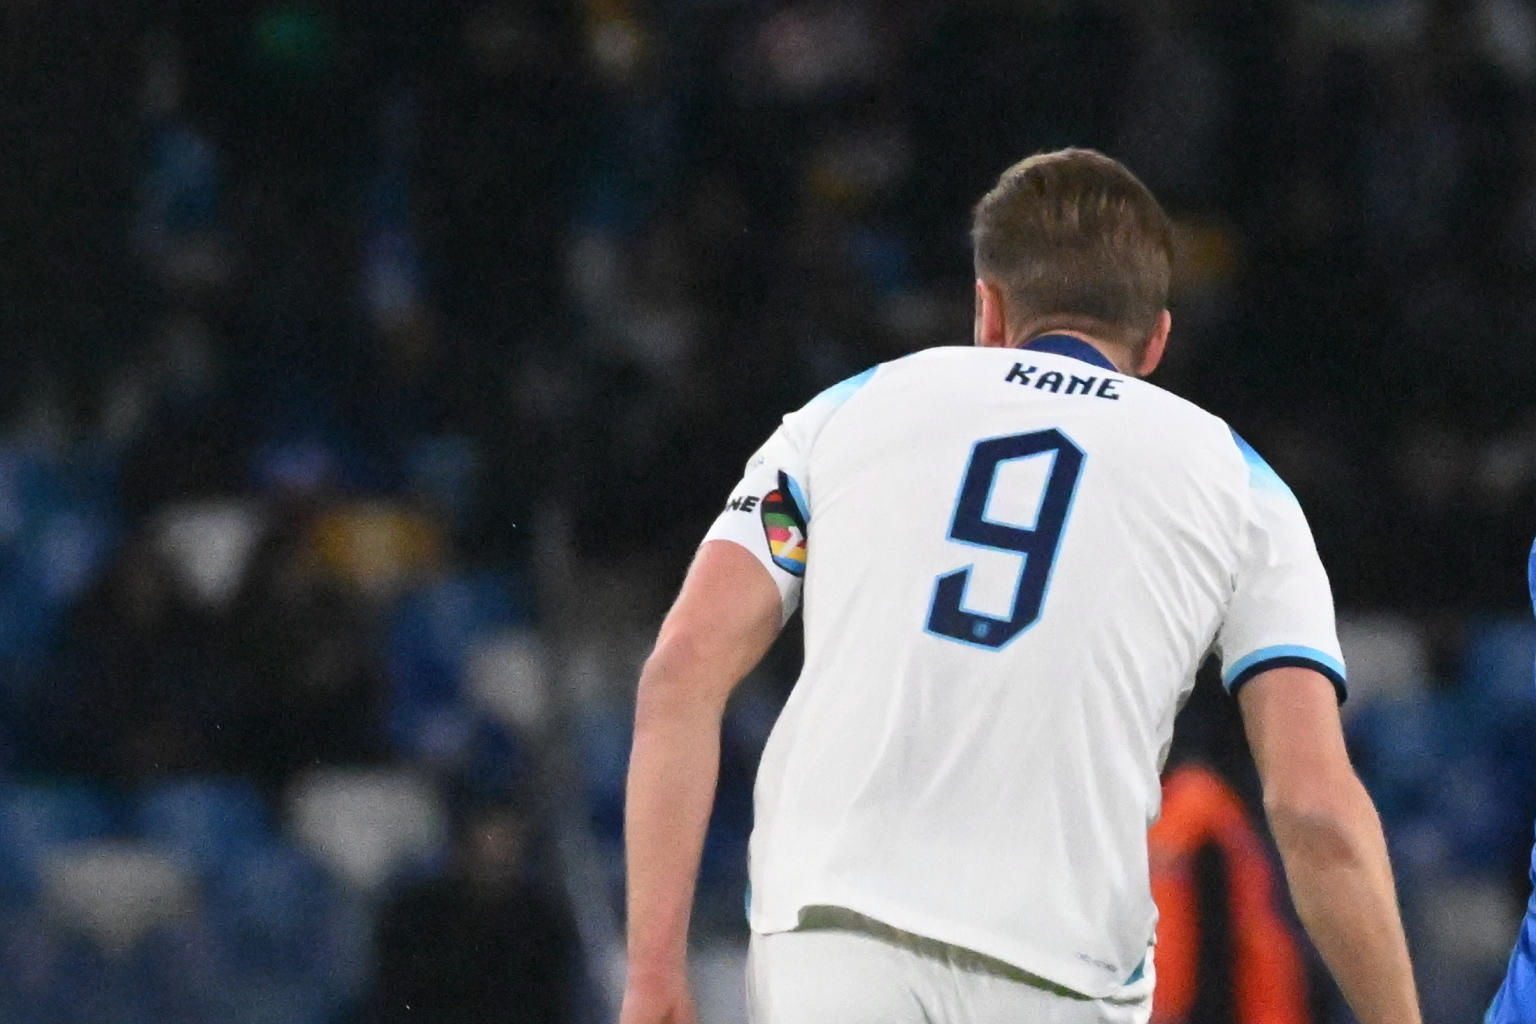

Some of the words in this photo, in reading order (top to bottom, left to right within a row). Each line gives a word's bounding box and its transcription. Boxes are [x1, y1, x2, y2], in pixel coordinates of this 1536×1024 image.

[1004, 362, 1123, 401] KANE
[726, 496, 761, 513] NE
[924, 428, 1088, 652] 9
